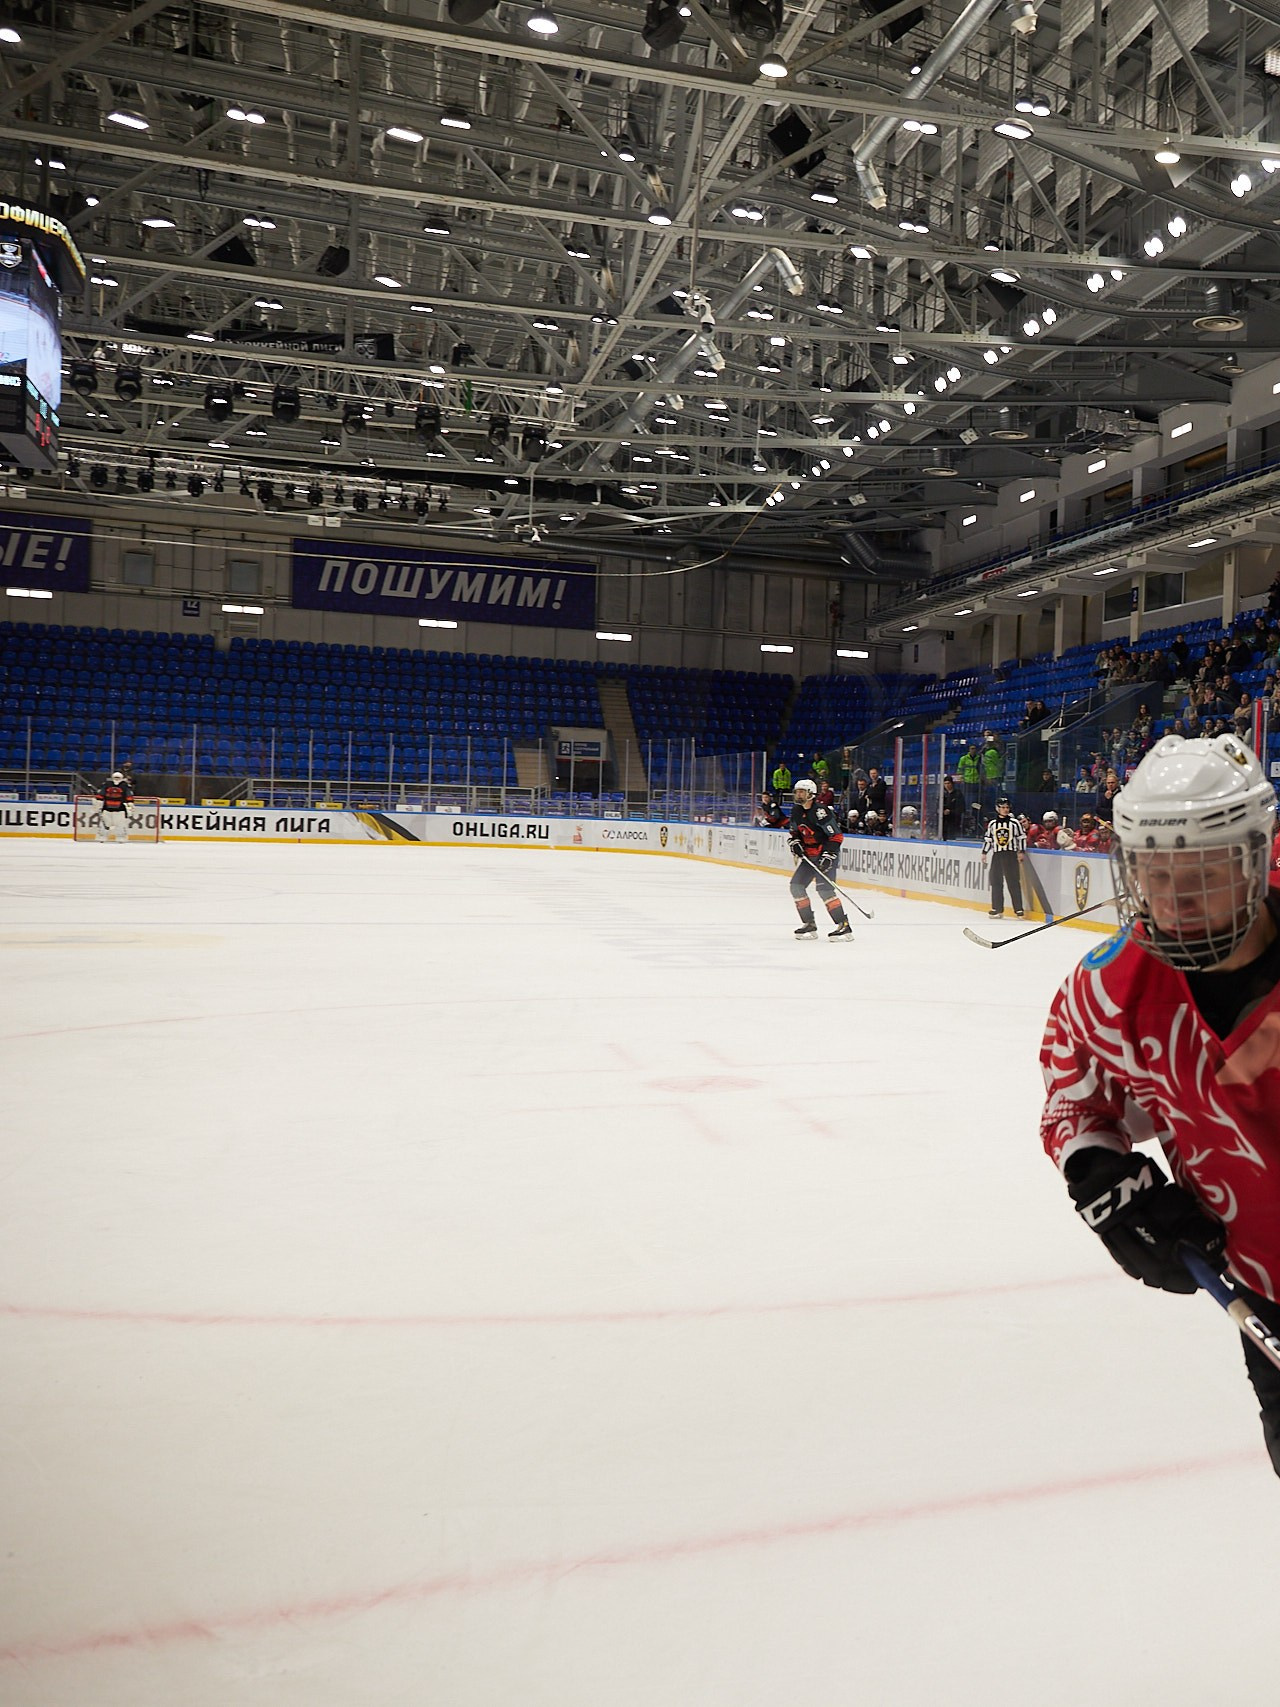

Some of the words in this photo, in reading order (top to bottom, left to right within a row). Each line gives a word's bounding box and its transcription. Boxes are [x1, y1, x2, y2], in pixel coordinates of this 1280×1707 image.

[317, 559, 568, 610] ПОШУМИМ!
[275, 817, 330, 833] ЛИГА
[453, 821, 549, 839] OHLIGA.RU
[1139, 818, 1188, 827] BAUER
[842, 848, 895, 872] ФИЦЕРСКАЯ
[897, 849, 960, 888] ХОККЕЙНАЯ
[964, 860, 992, 892] ЛИГ
[1080, 1164, 1154, 1228] CM
